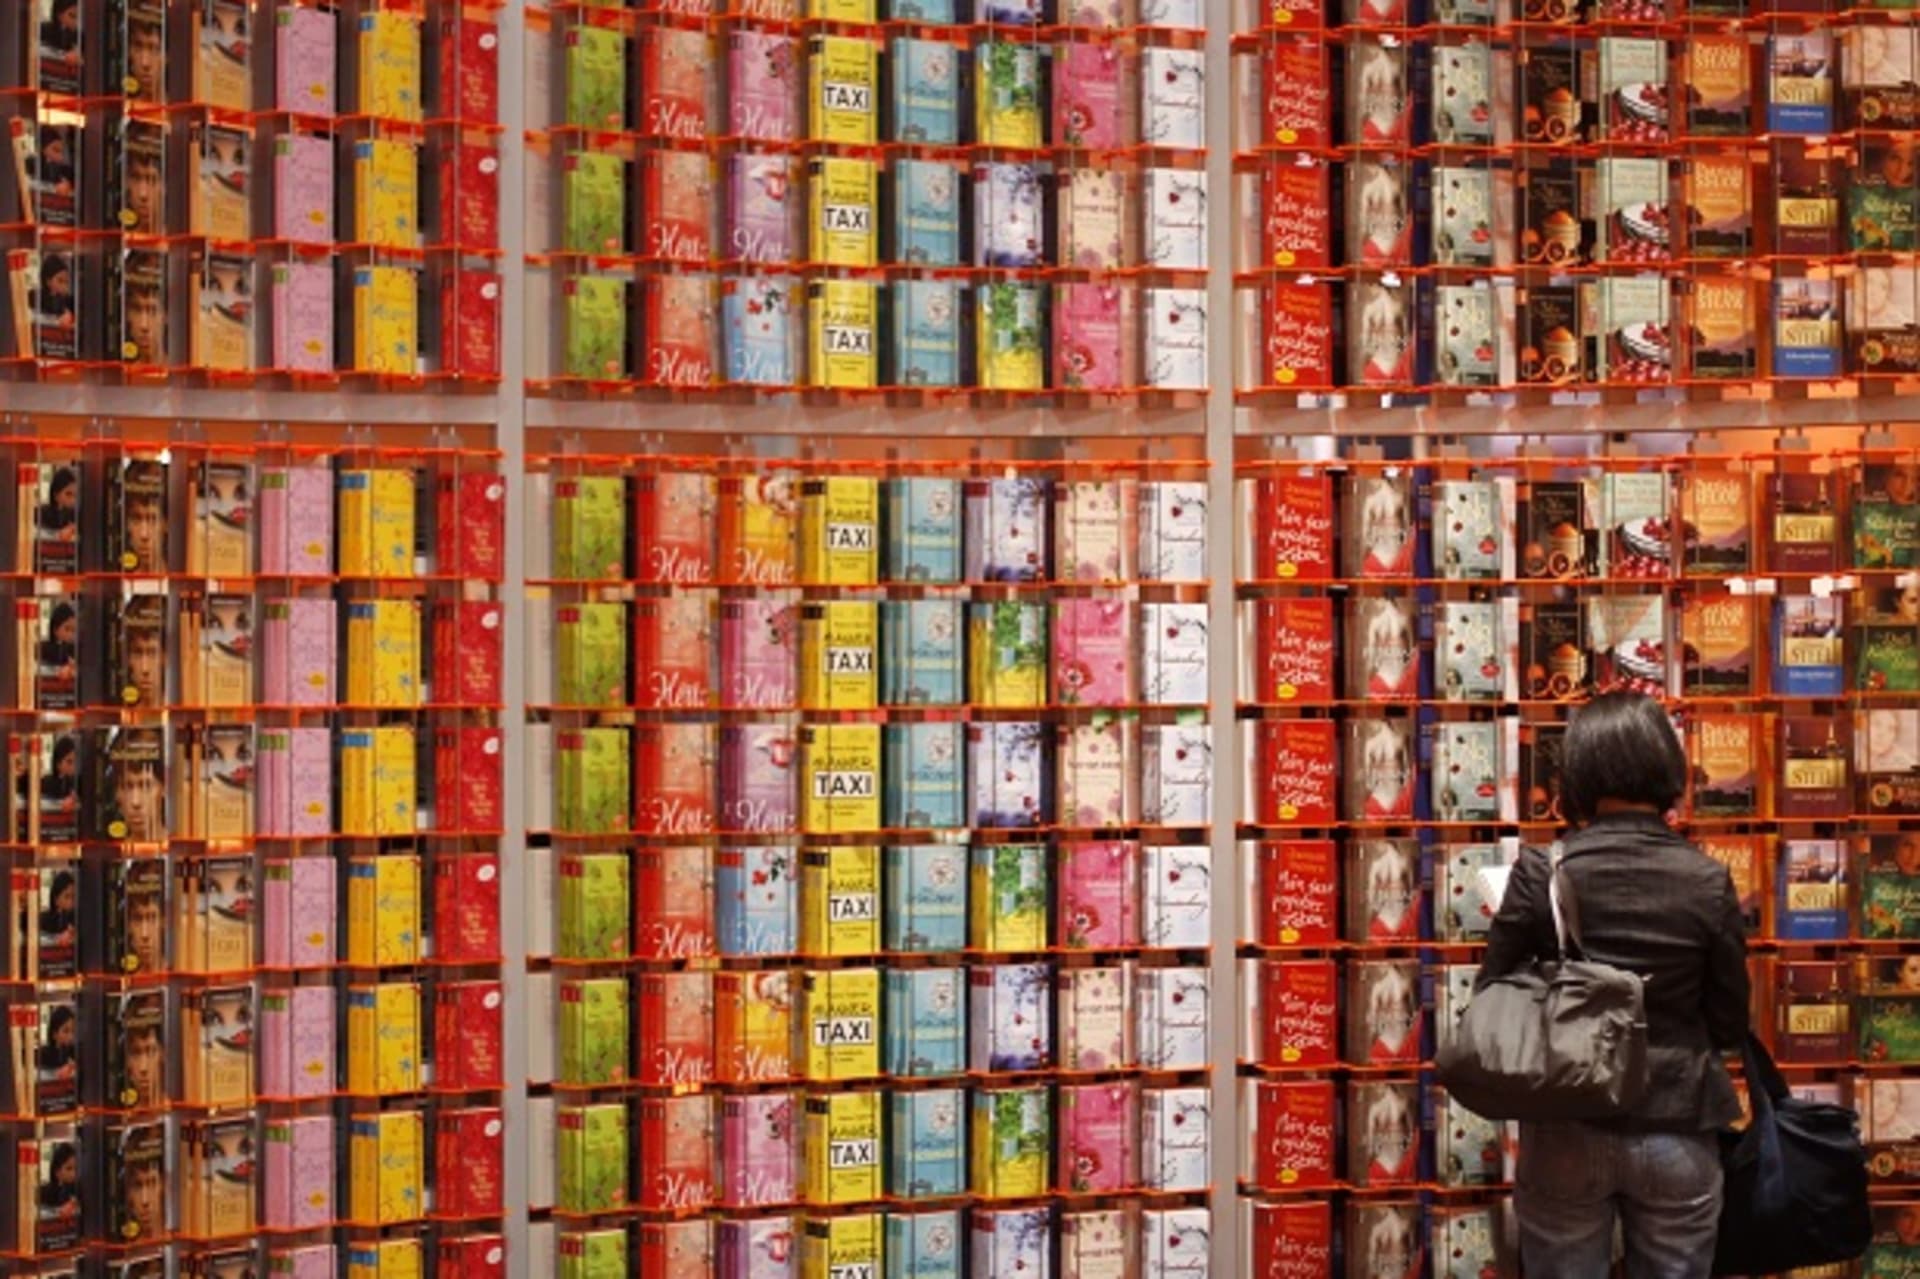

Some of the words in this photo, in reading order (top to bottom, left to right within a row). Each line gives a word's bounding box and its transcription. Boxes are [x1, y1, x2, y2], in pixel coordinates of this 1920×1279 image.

[825, 86, 869, 108] TAXI
[825, 207, 869, 230] TAXI
[827, 328, 871, 352] TAXI
[828, 526, 872, 548] TAXI
[827, 650, 872, 672] TAXI
[816, 774, 872, 796] TAXI
[830, 897, 874, 918] TAXI
[816, 1021, 872, 1043] TAXI
[831, 1144, 874, 1165] TAXI
